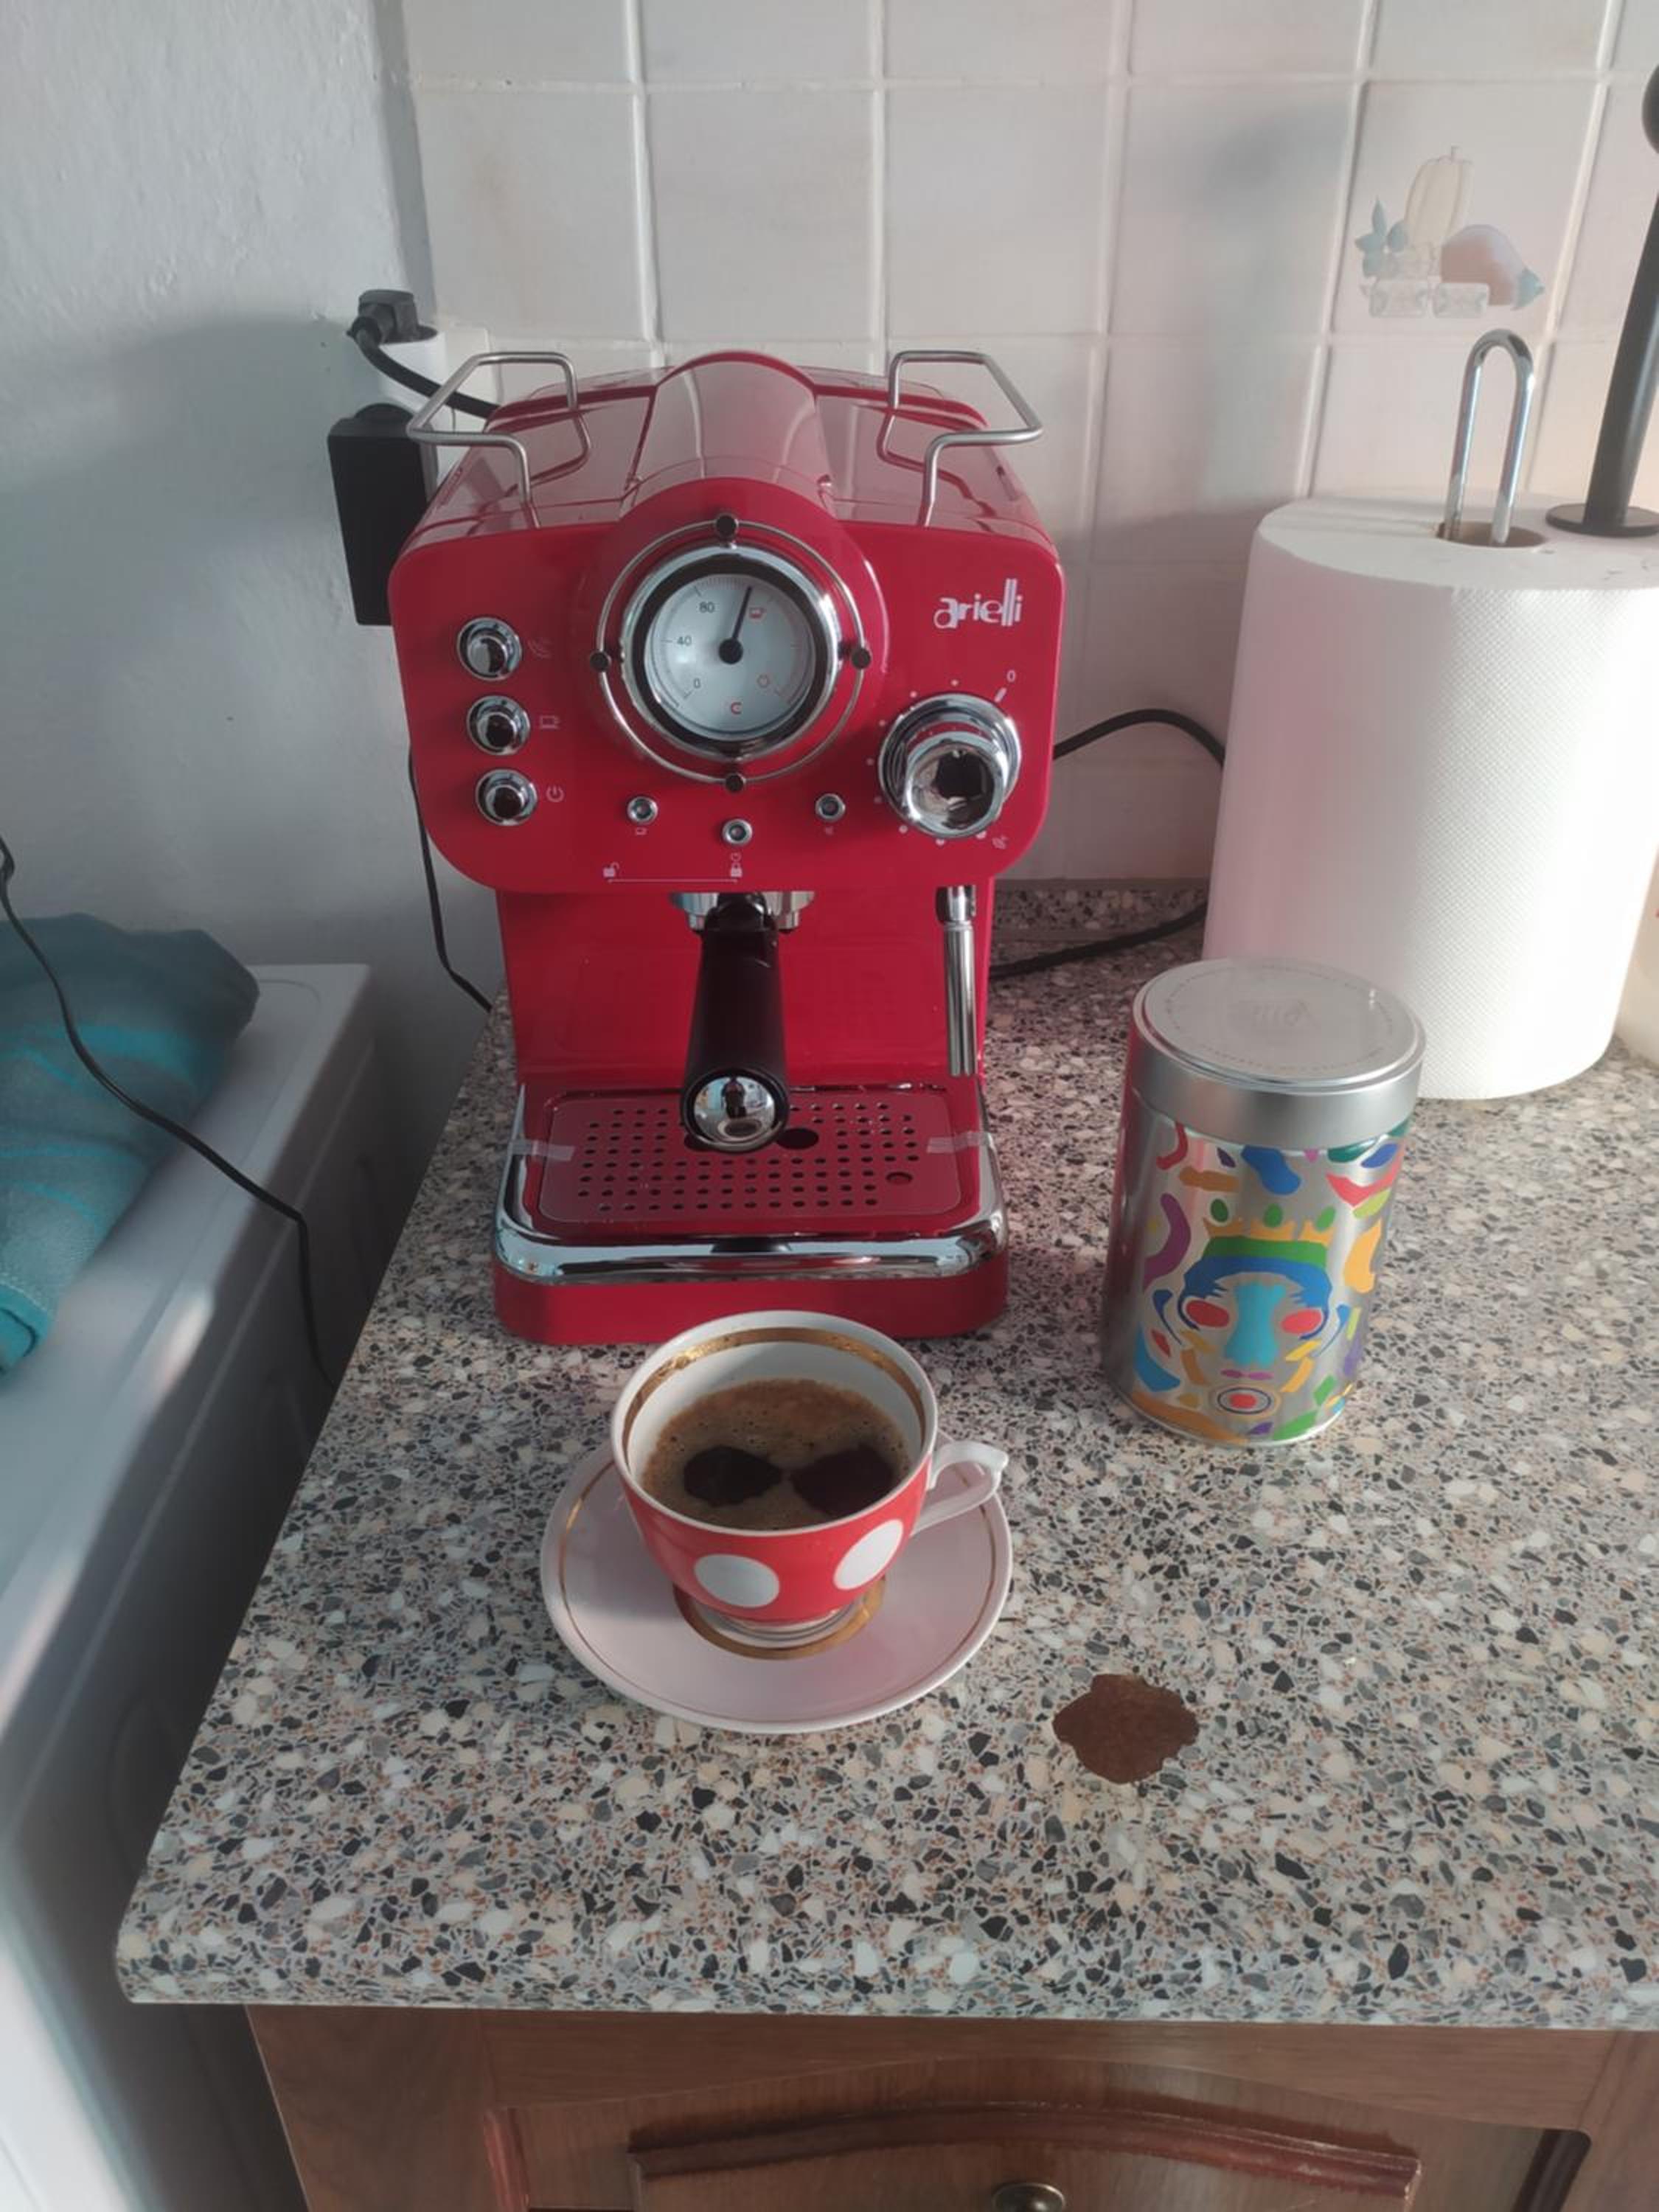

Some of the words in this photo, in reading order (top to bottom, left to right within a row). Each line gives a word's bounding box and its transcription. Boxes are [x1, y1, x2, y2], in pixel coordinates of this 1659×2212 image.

[699, 602, 715, 613] 80
[933, 578, 1023, 628] arielli
[677, 636, 692, 646] 40
[693, 678, 701, 689] 0
